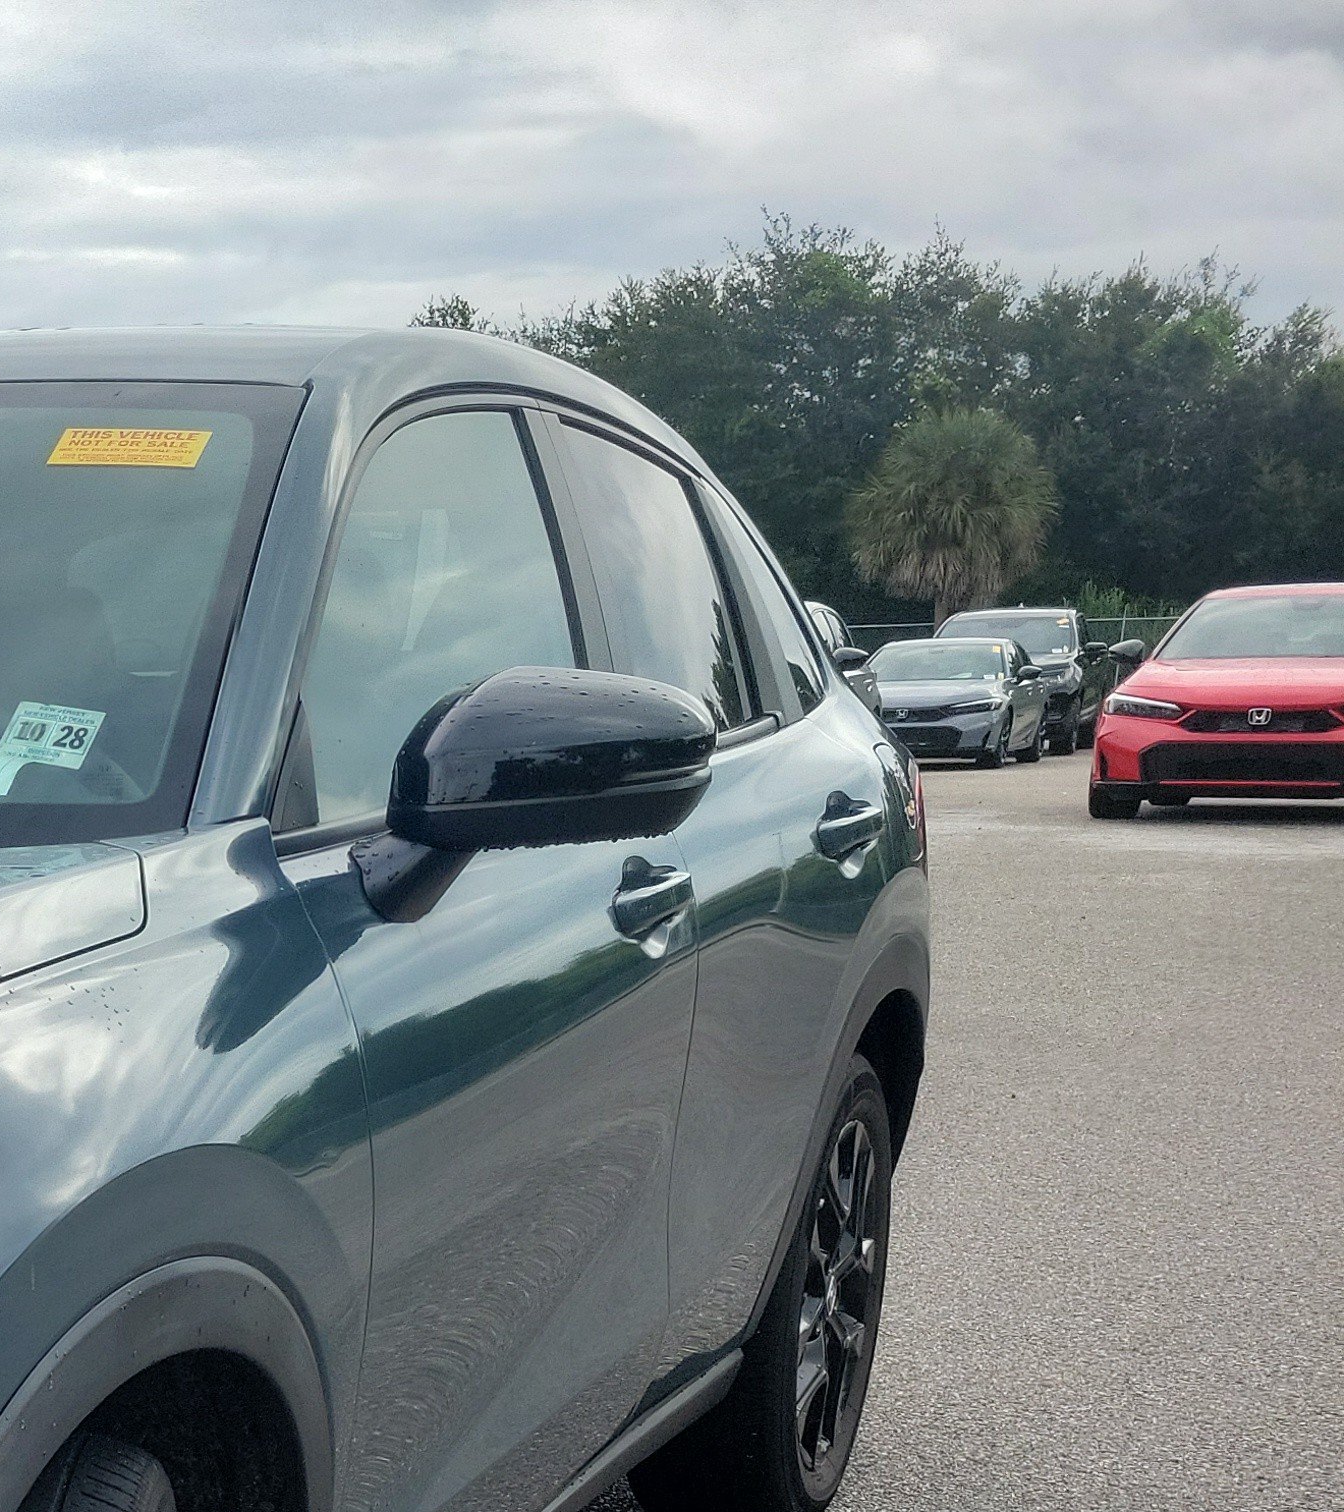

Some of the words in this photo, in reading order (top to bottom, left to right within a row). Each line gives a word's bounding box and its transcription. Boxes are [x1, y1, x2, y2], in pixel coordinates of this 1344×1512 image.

[70, 430, 113, 440] THIS
[119, 432, 200, 441] VEHICLE
[146, 441, 188, 449] SALE
[13, 721, 47, 742] 10
[52, 725, 89, 749] 28
